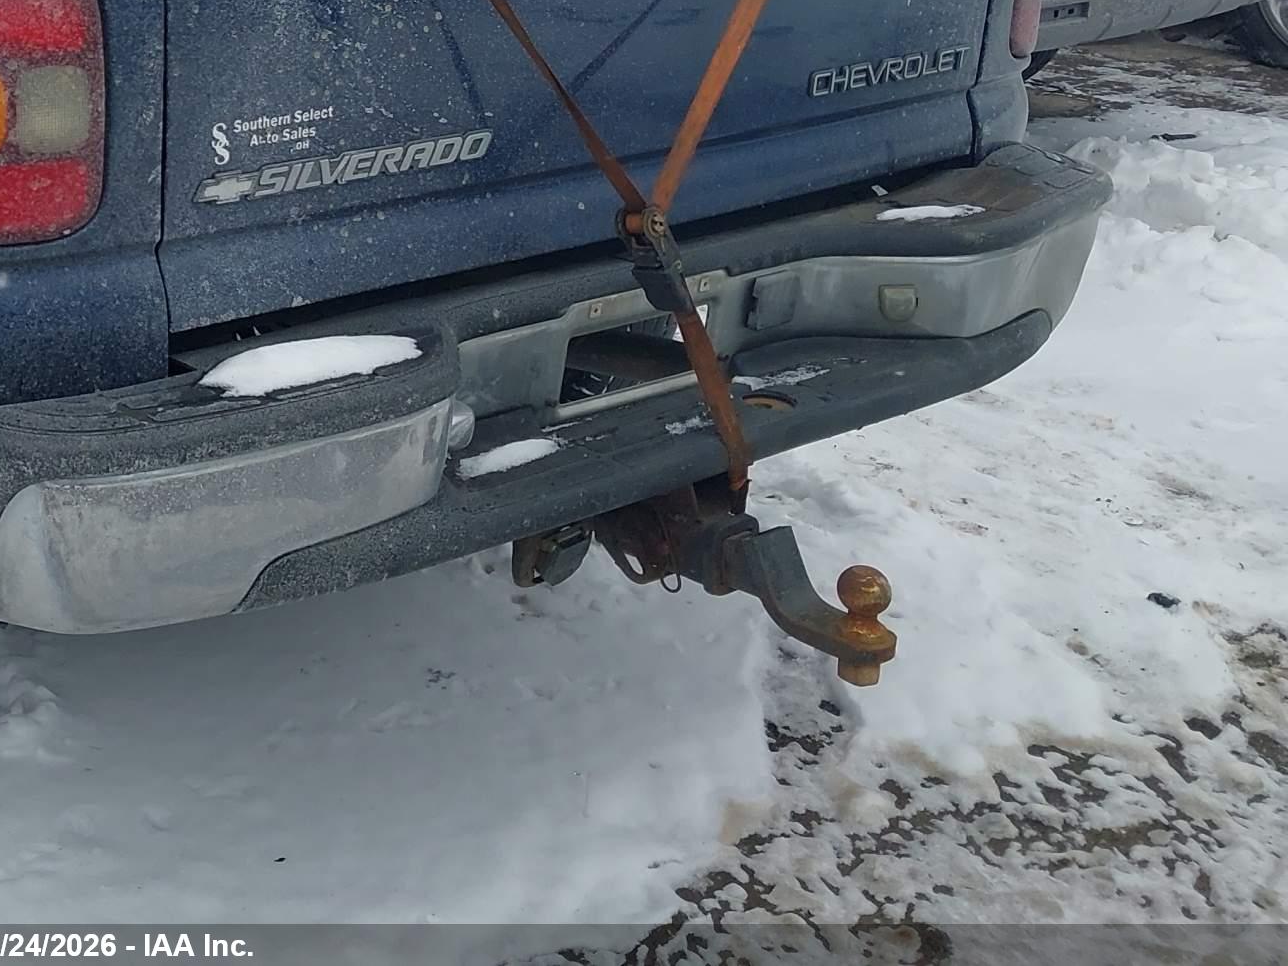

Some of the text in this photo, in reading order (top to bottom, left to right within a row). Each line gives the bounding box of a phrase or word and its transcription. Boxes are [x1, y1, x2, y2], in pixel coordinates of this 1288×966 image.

[812, 45, 972, 97] CHEVROLET
[233, 106, 334, 133] Southern Select
[282, 126, 317, 141] Sales
[252, 130, 493, 198] SILVERADO
